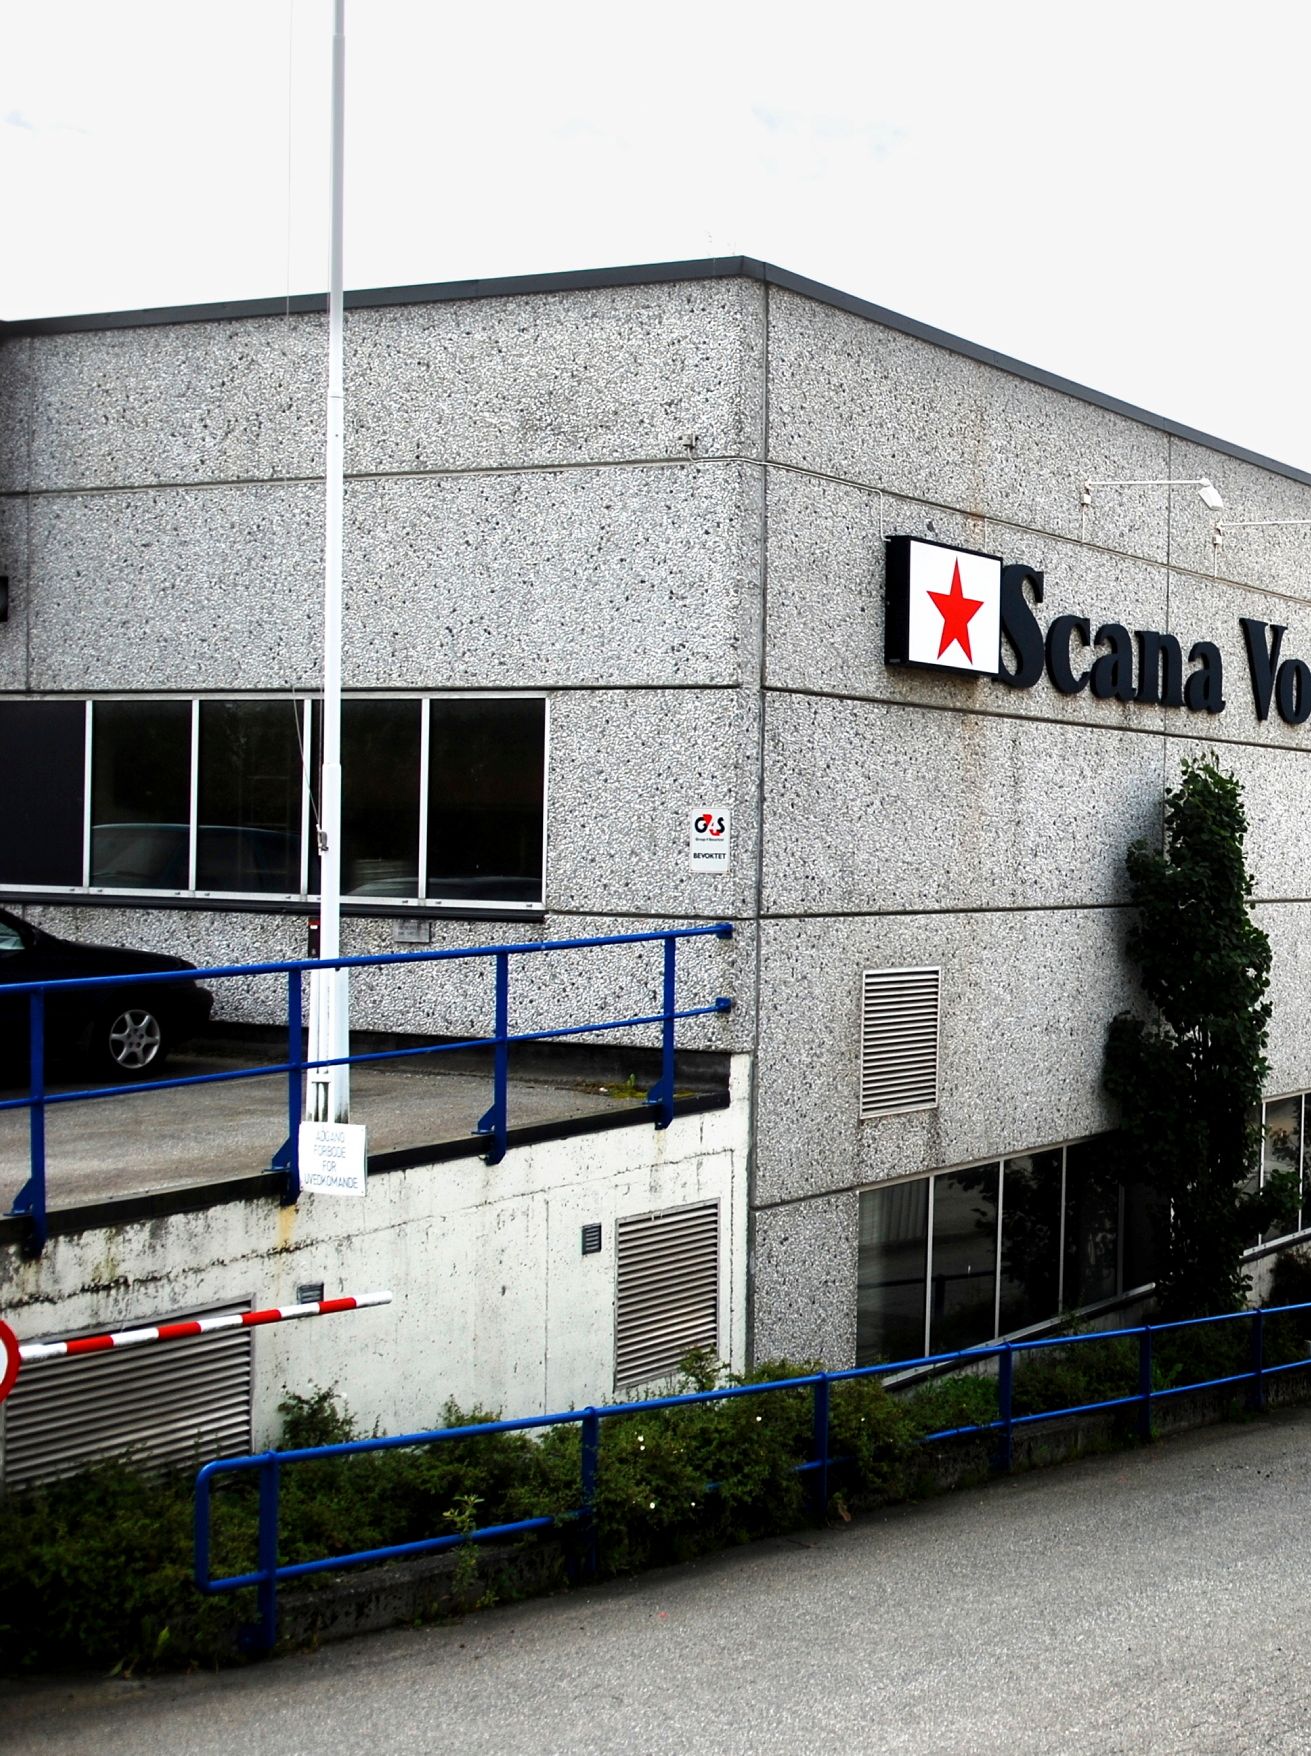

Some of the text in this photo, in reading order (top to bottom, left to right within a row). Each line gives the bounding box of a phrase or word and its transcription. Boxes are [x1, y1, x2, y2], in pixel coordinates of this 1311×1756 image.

[994, 564, 1226, 714] Scana
[694, 814, 725, 836] G4S
[322, 1160, 336, 1172] FOR
